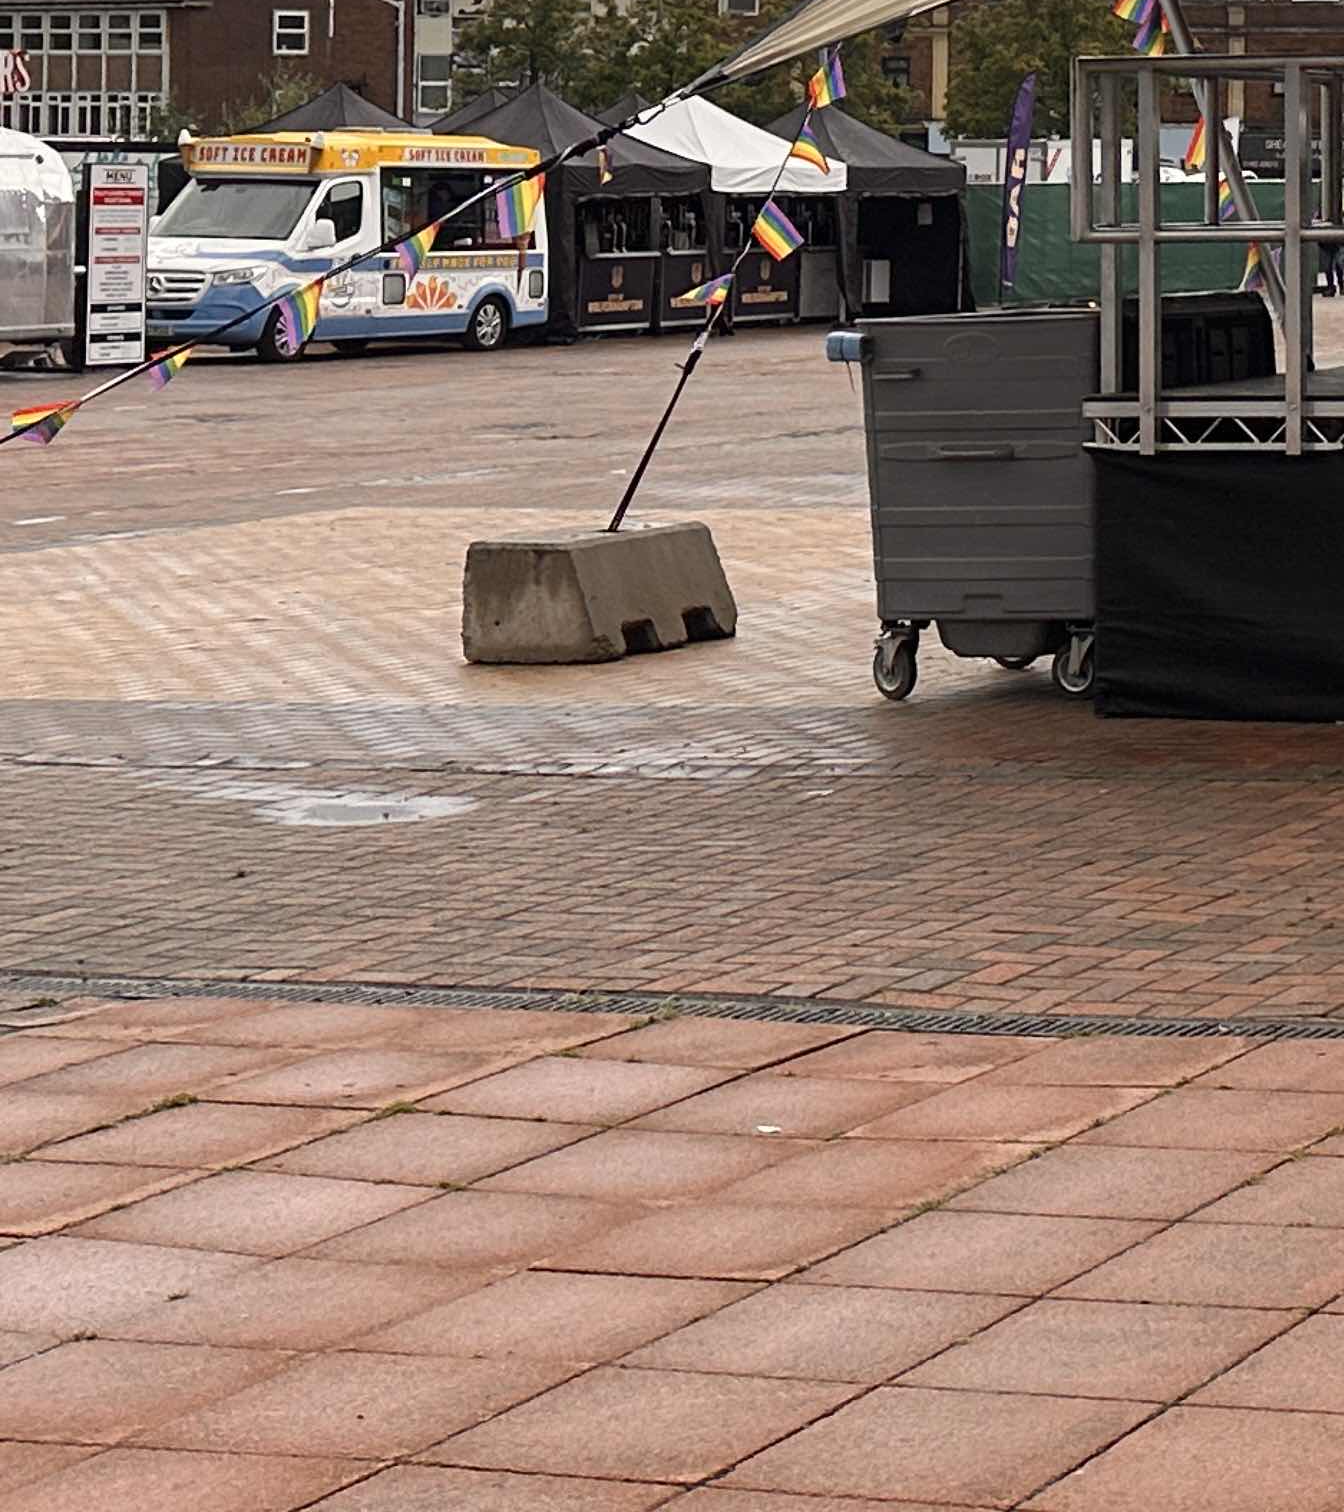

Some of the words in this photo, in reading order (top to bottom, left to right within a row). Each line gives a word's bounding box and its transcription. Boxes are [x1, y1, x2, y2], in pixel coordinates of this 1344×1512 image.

[198, 145, 228, 162] SOFT
[232, 146, 257, 162] ICE
[260, 147, 307, 164] CREAM
[409, 148, 432, 161] SOFT
[435, 149, 451, 162] ICE
[454, 149, 485, 162] CREAM
[104, 171, 133, 182] MENU
